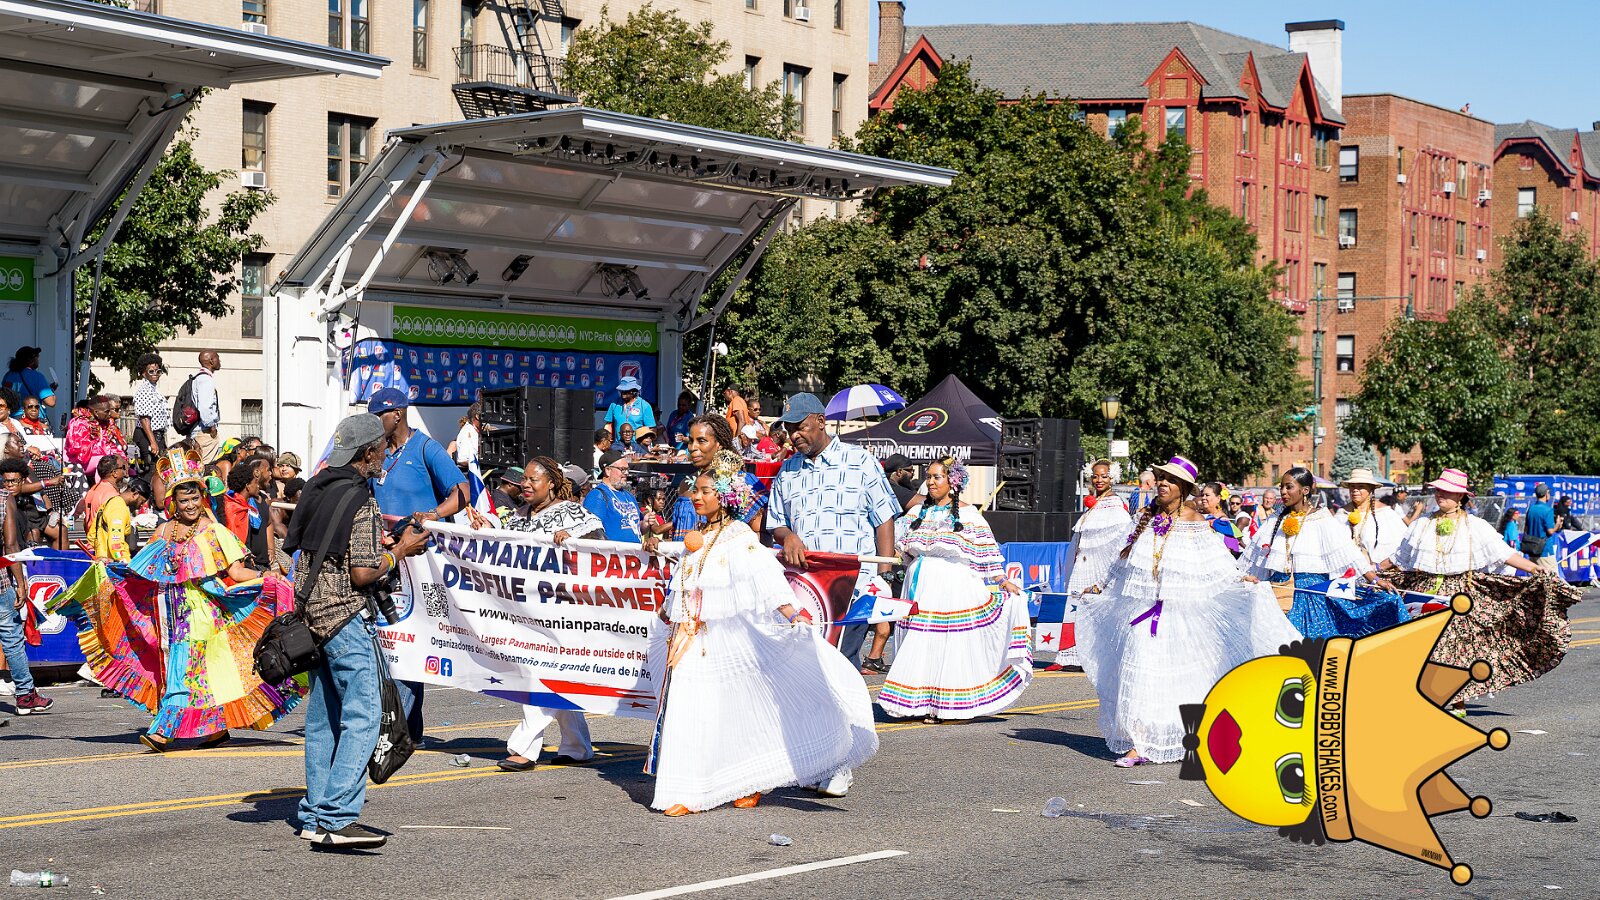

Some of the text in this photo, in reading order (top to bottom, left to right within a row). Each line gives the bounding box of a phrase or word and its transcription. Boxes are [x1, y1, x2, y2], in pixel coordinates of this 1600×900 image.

[579, 330, 613, 342] NYC Parks
[443, 564, 527, 602] DESFILE
[438, 622, 470, 636] Organizers
[480, 635, 508, 646] Largest
[508, 638, 558, 654] Panamanian
[560, 645, 591, 657] Parade
[593, 648, 625, 659] outside
[626, 650, 635, 660] of
[479, 608, 648, 638] www.panamanianparade.org
[430, 637, 475, 653] Organizadores
[500, 652, 539, 667] Panameño
[539, 659, 559, 669] más
[559, 663, 590, 673] grande
[592, 664, 616, 675] fuera
[618, 666, 630, 676] de
[631, 667, 639, 677] la
